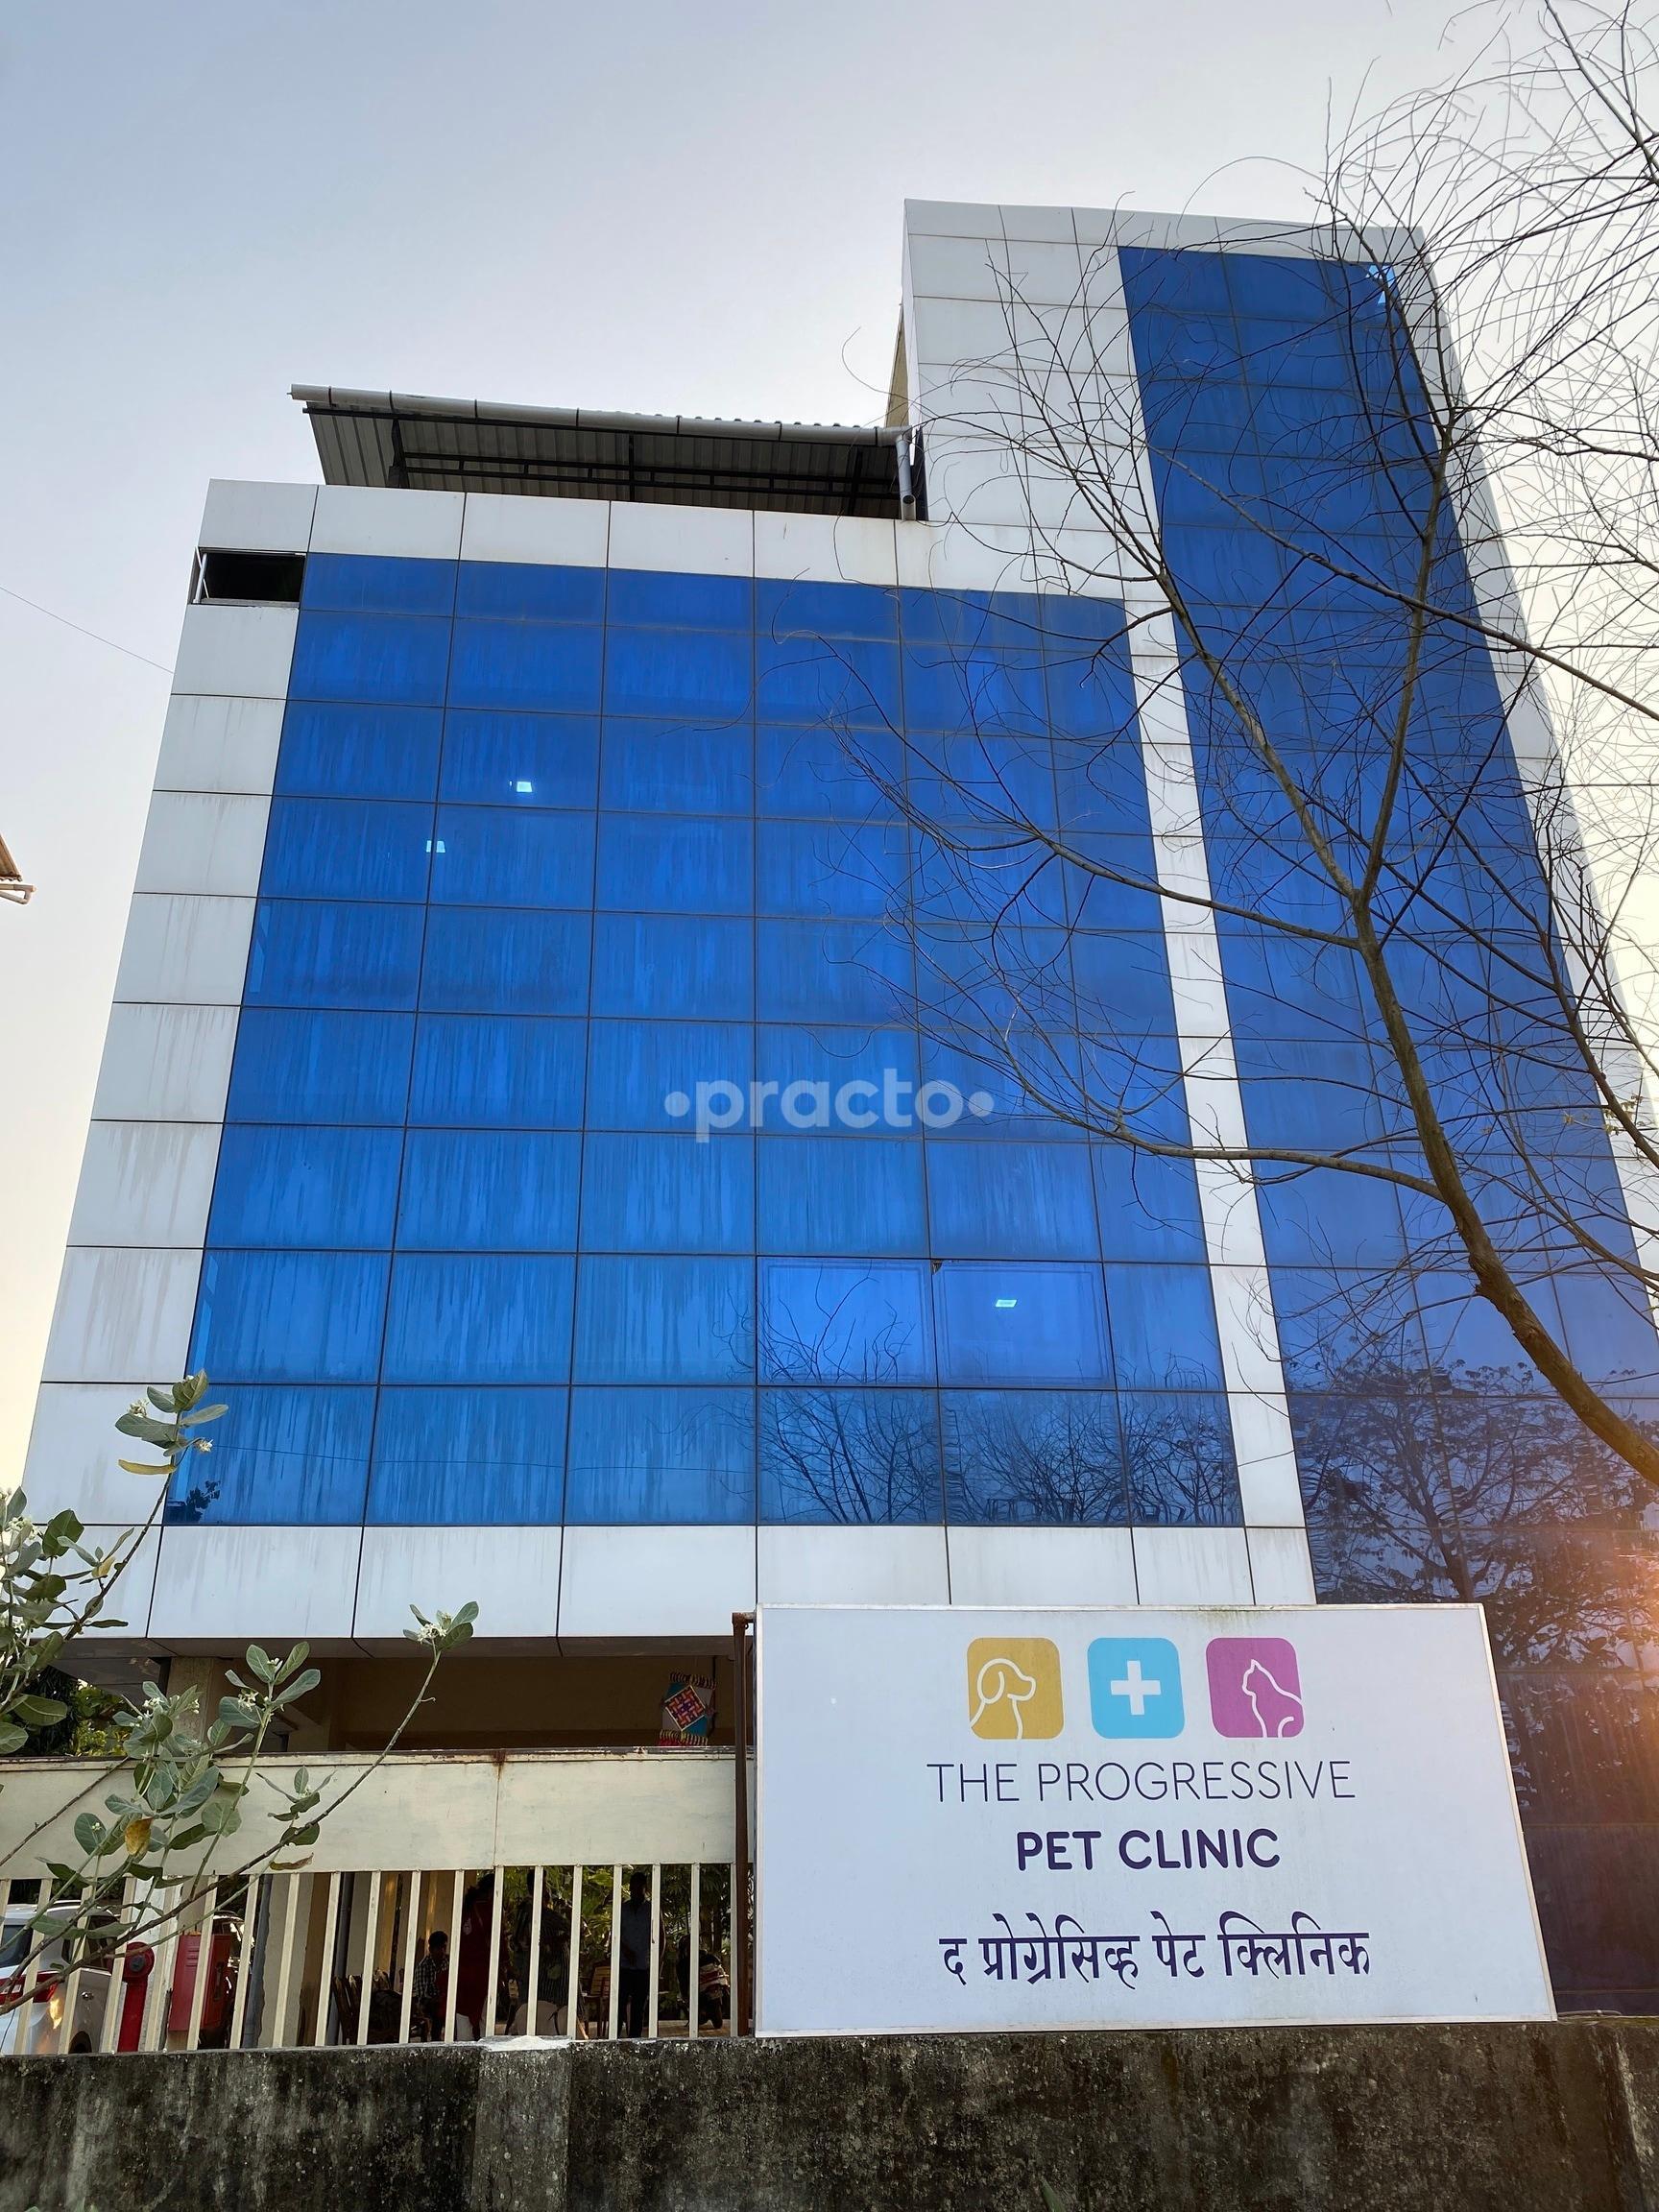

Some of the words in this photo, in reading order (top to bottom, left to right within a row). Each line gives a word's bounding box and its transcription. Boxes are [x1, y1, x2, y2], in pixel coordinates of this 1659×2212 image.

[926, 1763, 1021, 1804] THE
[1038, 1760, 1357, 1803] PROGRESSIVE
[1016, 1830, 1102, 1872] PET
[1118, 1828, 1282, 1871] CLINIC
[937, 1937, 968, 1986] द
[976, 1911, 1142, 1990] प्रोग्रेसिव्ह
[1149, 1910, 1207, 1979] पेट
[1216, 1911, 1371, 1981] क्लिनिक
